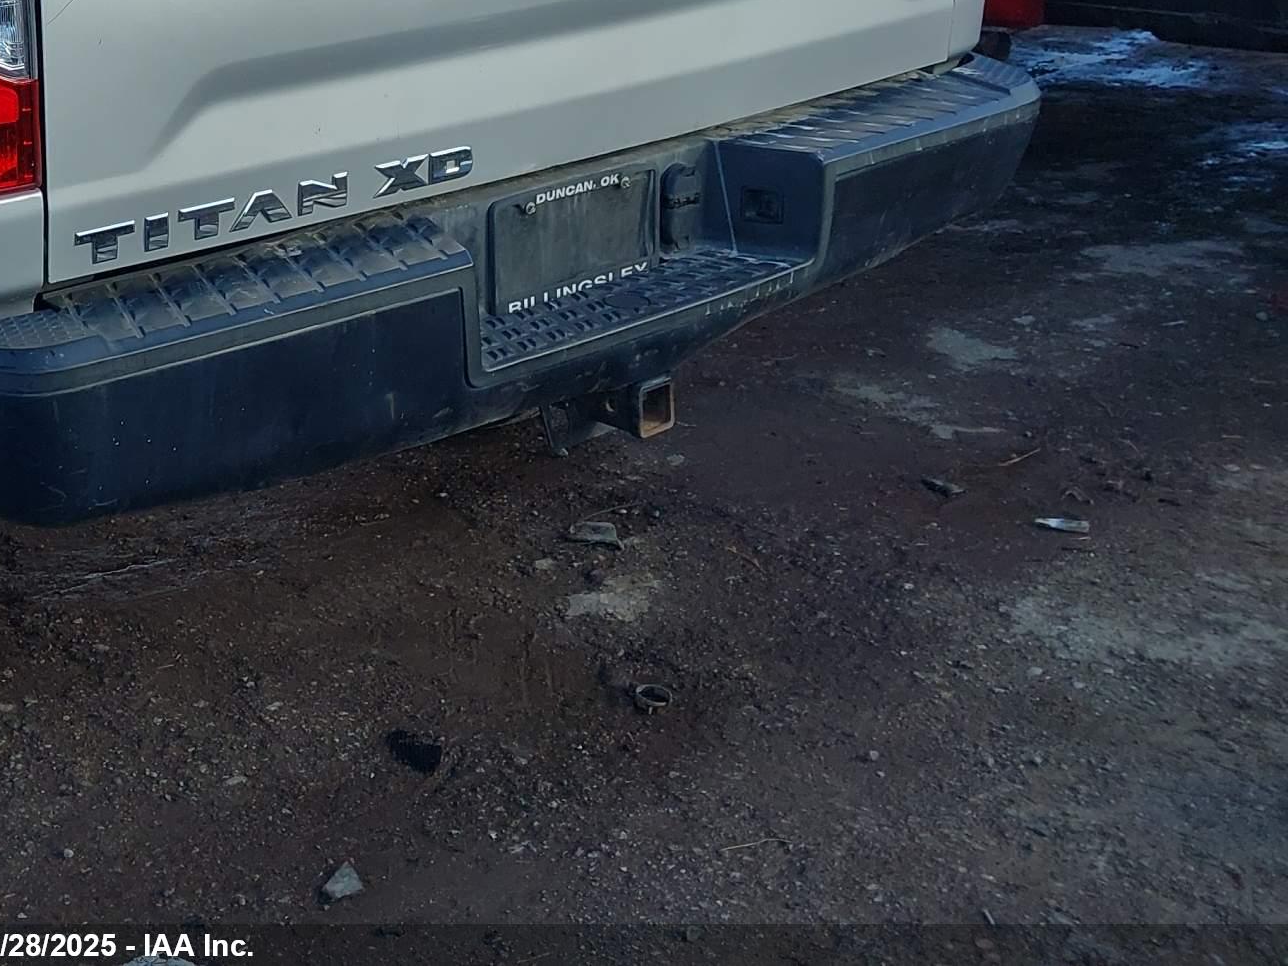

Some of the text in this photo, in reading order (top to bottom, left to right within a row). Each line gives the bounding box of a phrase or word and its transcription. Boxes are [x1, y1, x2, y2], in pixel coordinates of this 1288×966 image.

[74, 145, 473, 265] TITAN XD
[600, 173, 620, 187] OK
